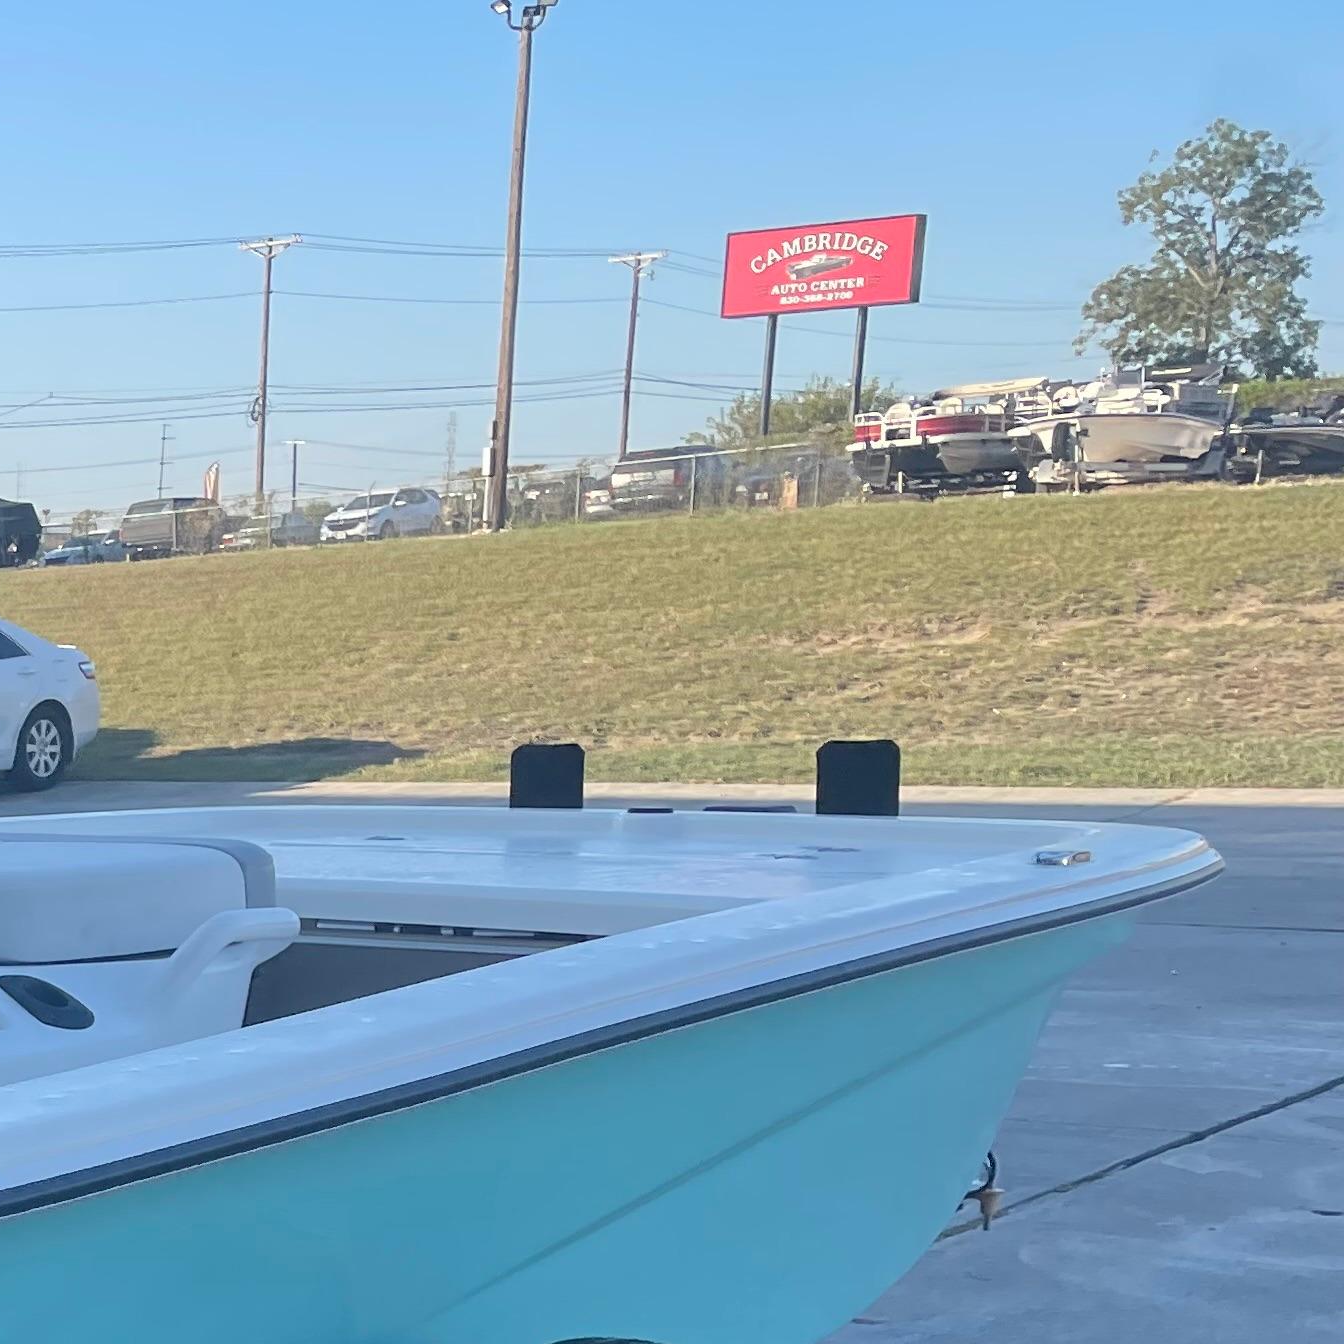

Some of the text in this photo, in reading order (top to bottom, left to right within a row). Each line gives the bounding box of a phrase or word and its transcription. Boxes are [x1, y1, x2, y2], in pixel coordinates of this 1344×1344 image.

[749, 232, 889, 274] CAMBRIDGE
[771, 277, 865, 295] AUTO CENTER
